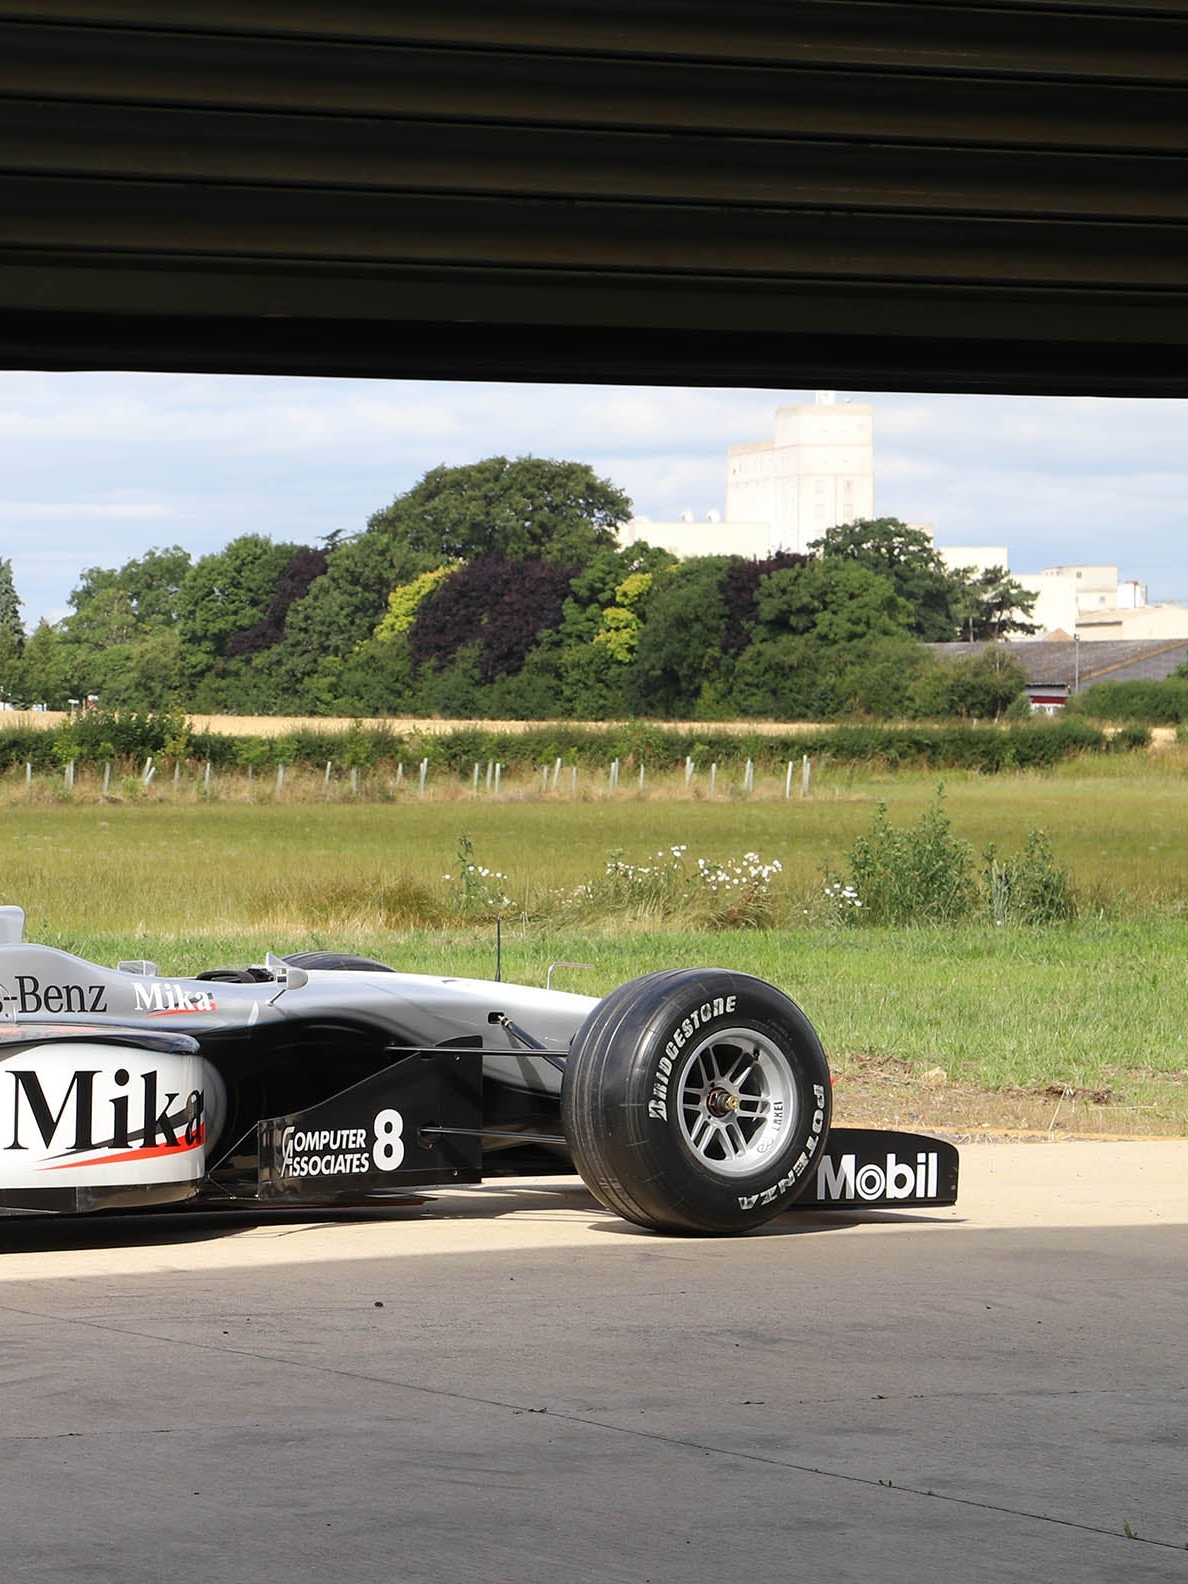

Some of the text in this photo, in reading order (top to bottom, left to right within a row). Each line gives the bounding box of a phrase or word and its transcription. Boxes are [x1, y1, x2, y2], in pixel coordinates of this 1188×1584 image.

[131, 982, 213, 1012] Mika
[647, 995, 737, 1122] BRIDGESTONE
[3, 1068, 205, 1150] Mika
[372, 1108, 405, 1171] 8
[737, 1083, 825, 1210] POTENZA
[816, 1152, 938, 1201] Mobil
